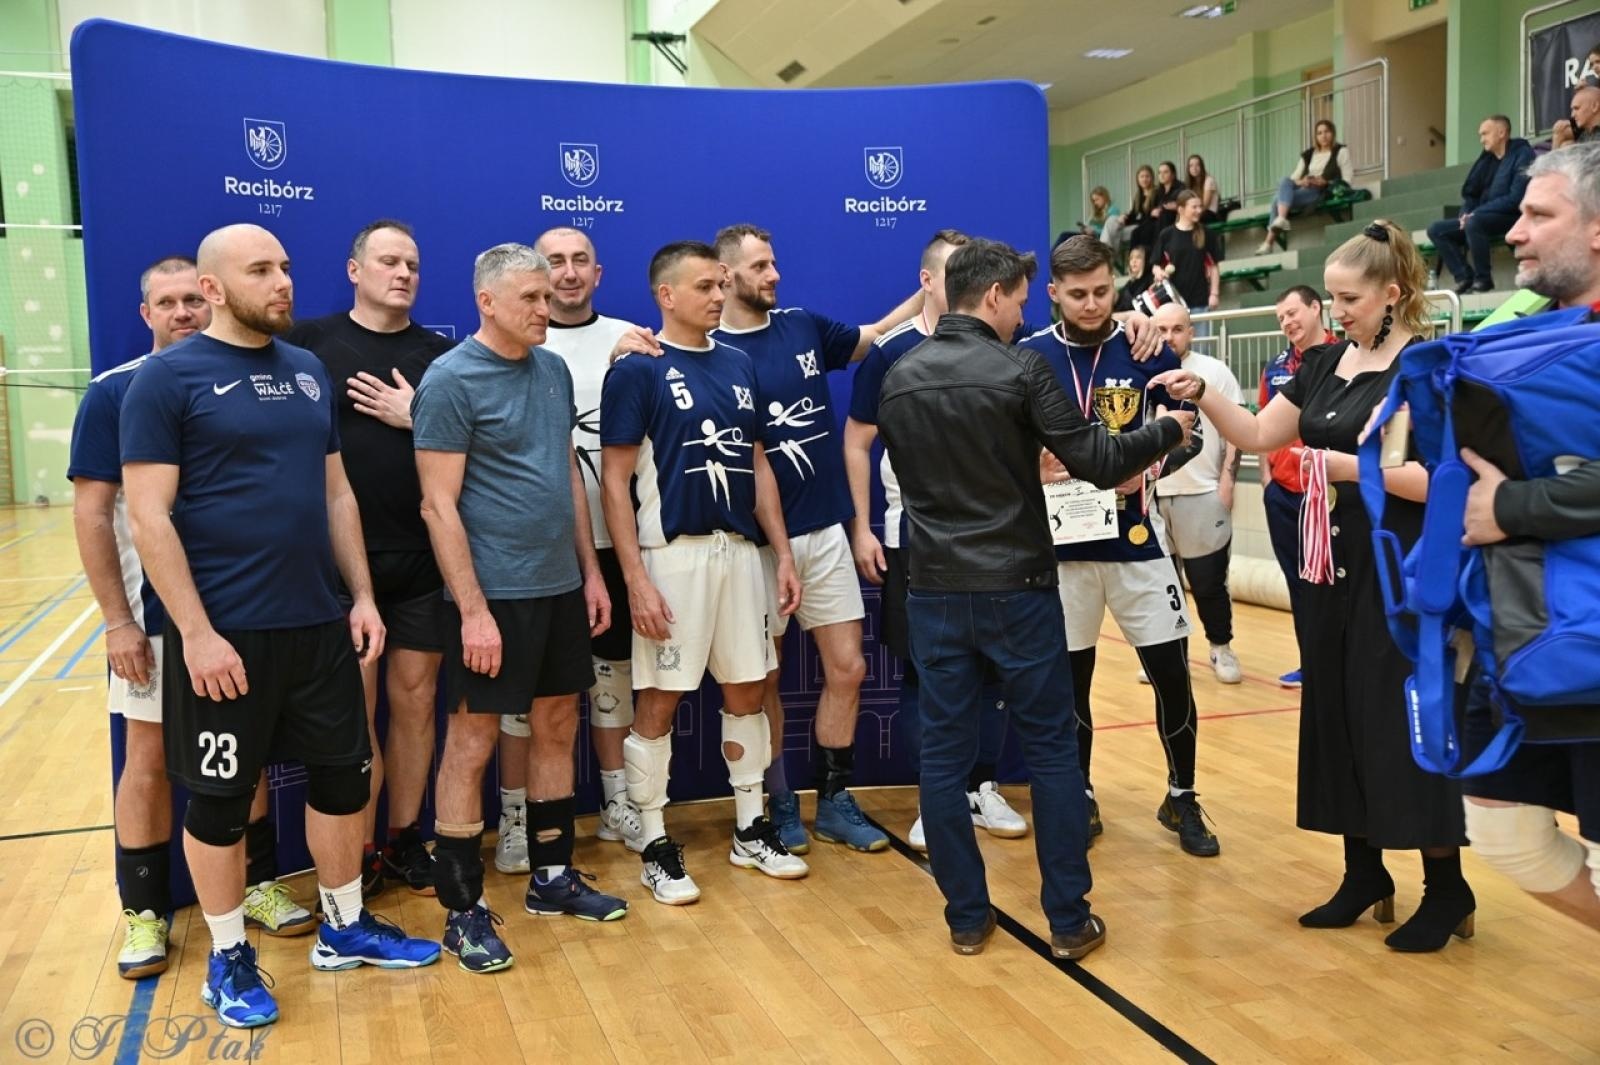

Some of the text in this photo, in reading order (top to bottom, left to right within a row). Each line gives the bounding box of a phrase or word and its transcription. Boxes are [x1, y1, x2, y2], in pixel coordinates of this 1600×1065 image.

[224, 175, 315, 201] Racibórz
[258, 203, 283, 218] 1217
[541, 194, 625, 212] Racibórz
[844, 195, 927, 213] Racibórz
[572, 217, 595, 230] 1217
[874, 217, 897, 230] 1217
[669, 381, 695, 411] 5
[1166, 584, 1182, 612] 3
[198, 730, 239, 780] 23
